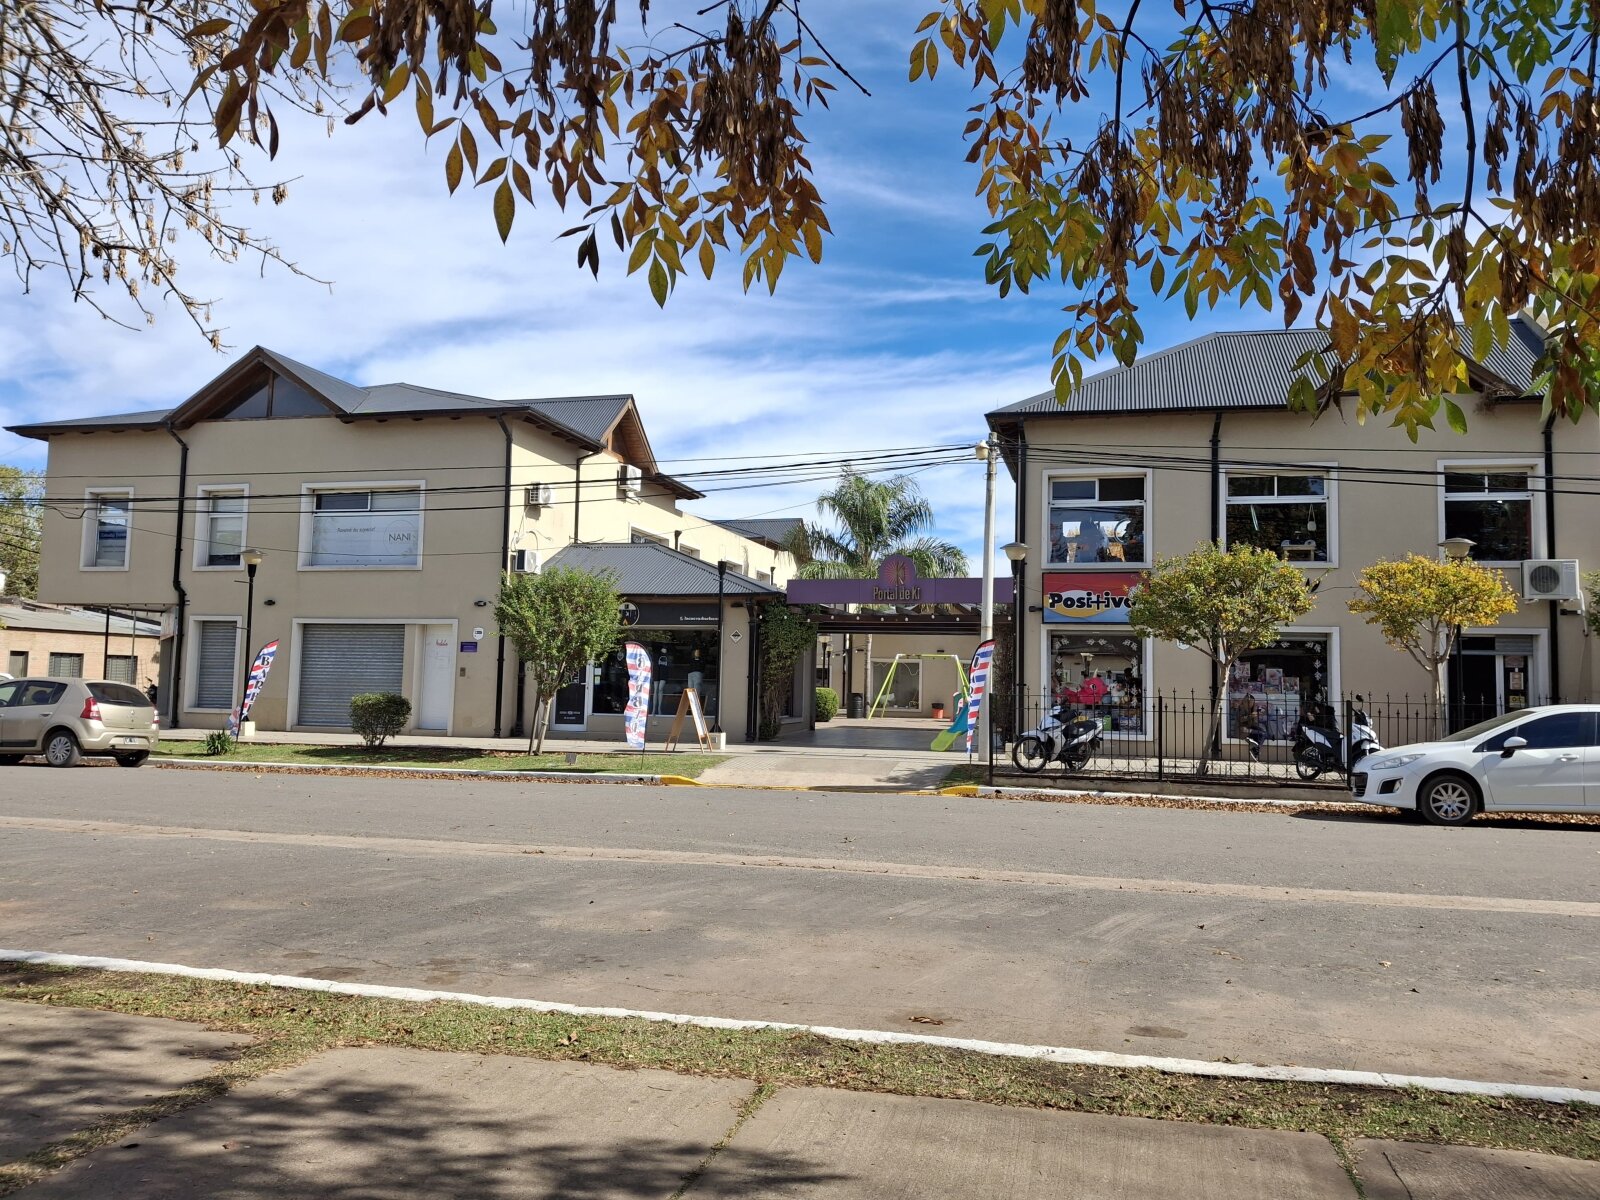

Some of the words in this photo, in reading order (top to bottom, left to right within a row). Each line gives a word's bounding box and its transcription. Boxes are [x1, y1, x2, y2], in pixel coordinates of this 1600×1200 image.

[388, 532, 411, 541] NANI
[873, 585, 898, 600] Portal
[900, 586, 910, 600] de
